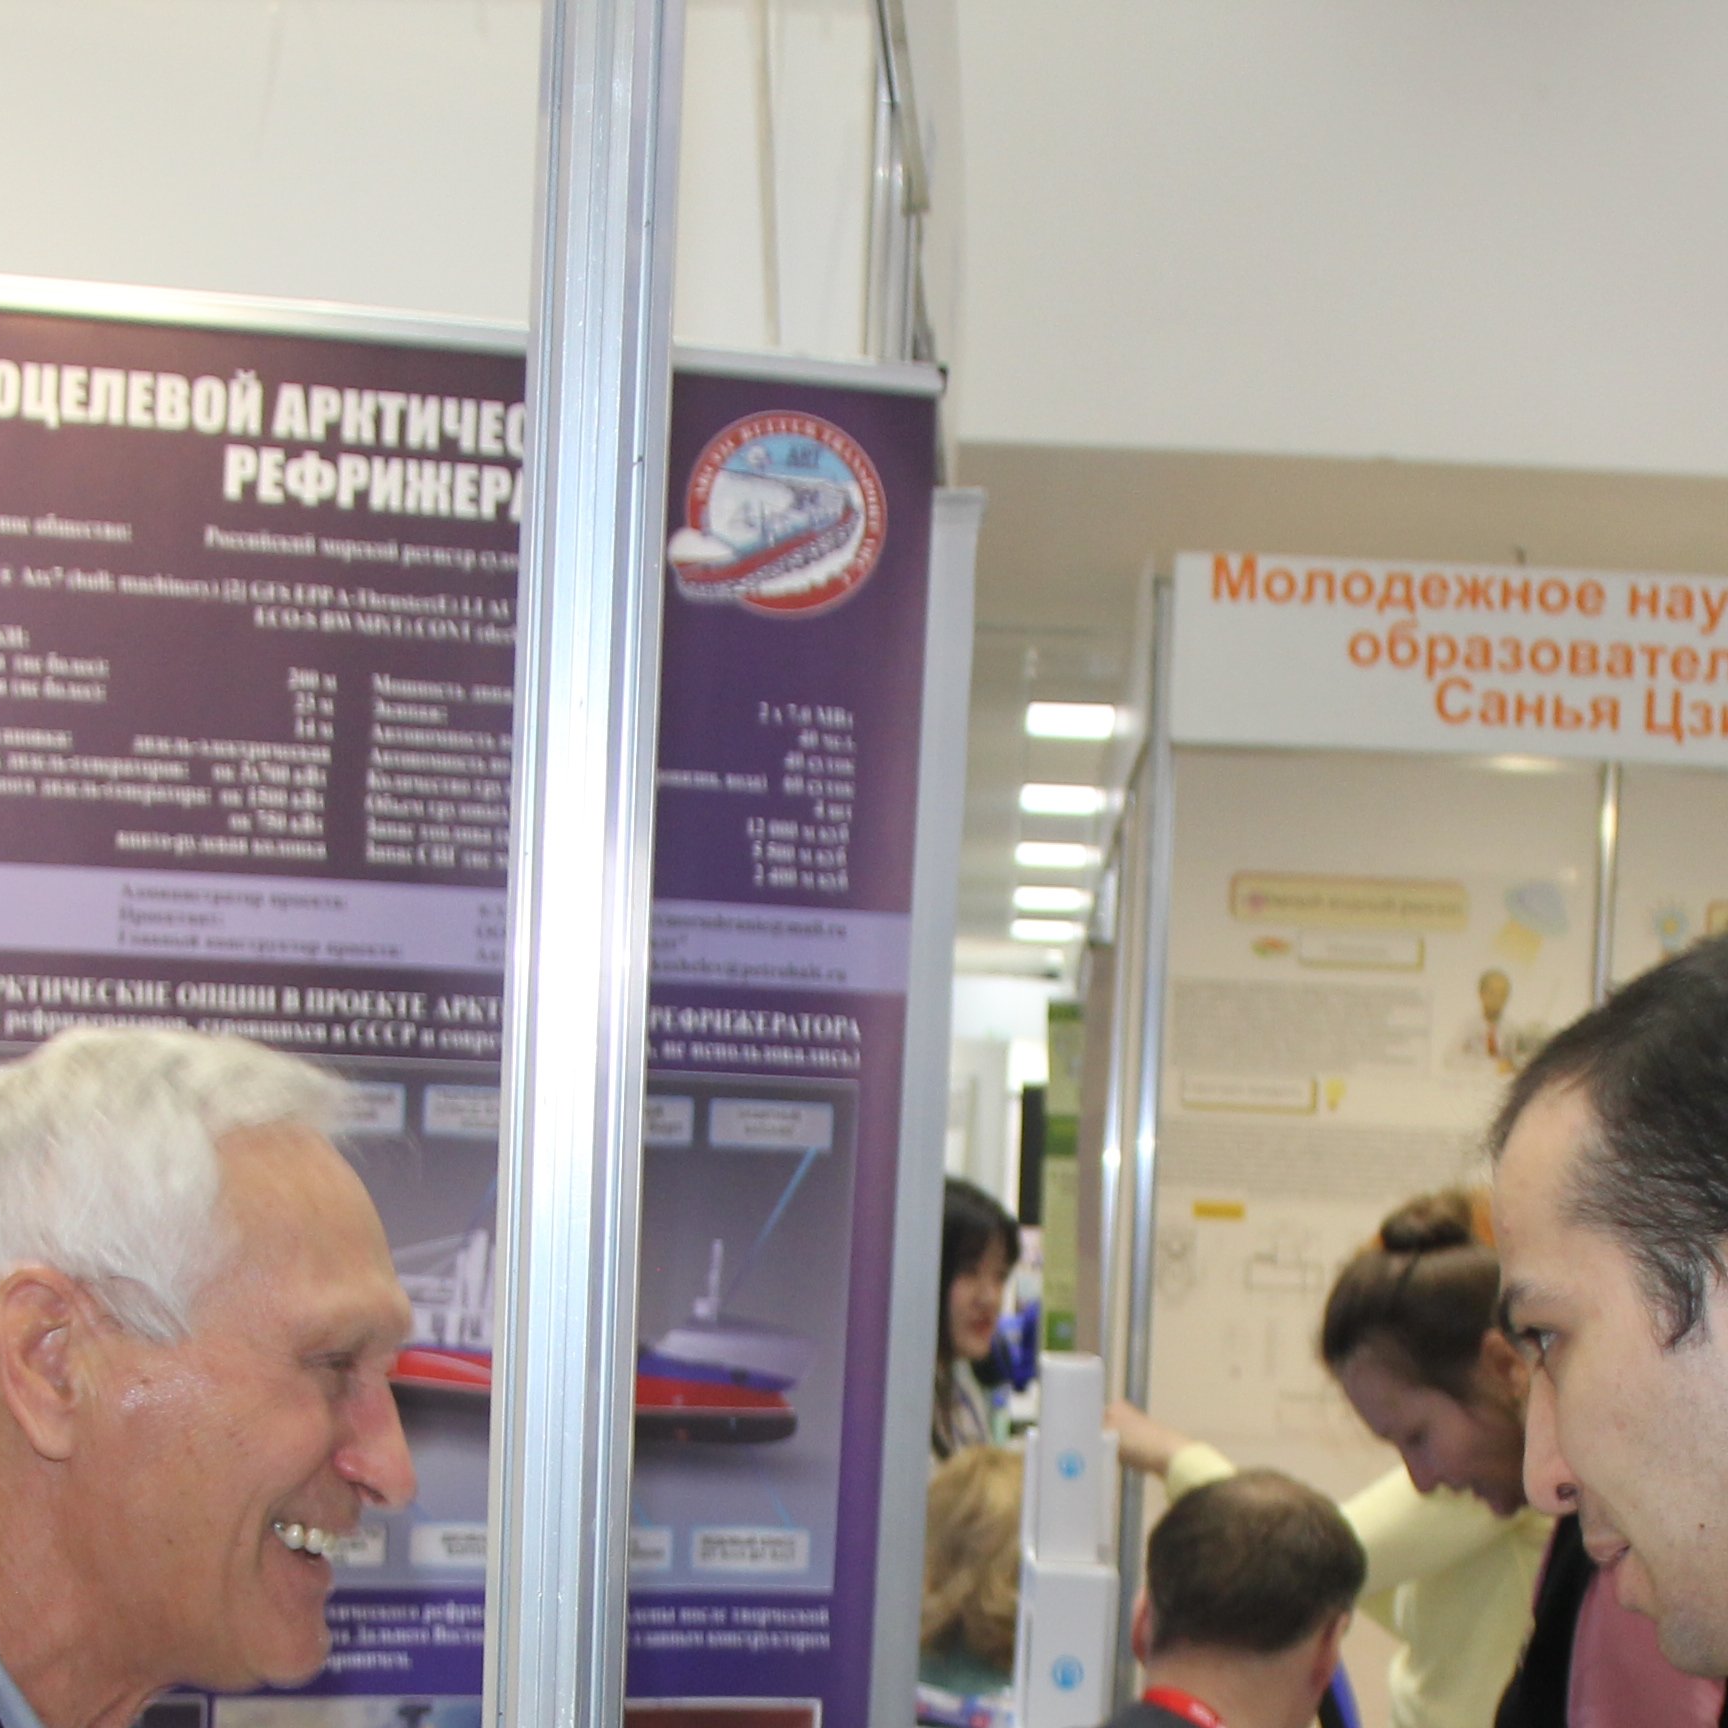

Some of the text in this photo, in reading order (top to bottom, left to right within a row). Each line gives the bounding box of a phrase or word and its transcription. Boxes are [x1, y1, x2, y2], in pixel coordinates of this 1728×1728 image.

[1210, 551, 1606, 616] Молодежное
[1434, 675, 1621, 733] Санья
[281, 985, 302, 1015] В
[304, 986, 428, 1021] ПРОЕКТЕ
